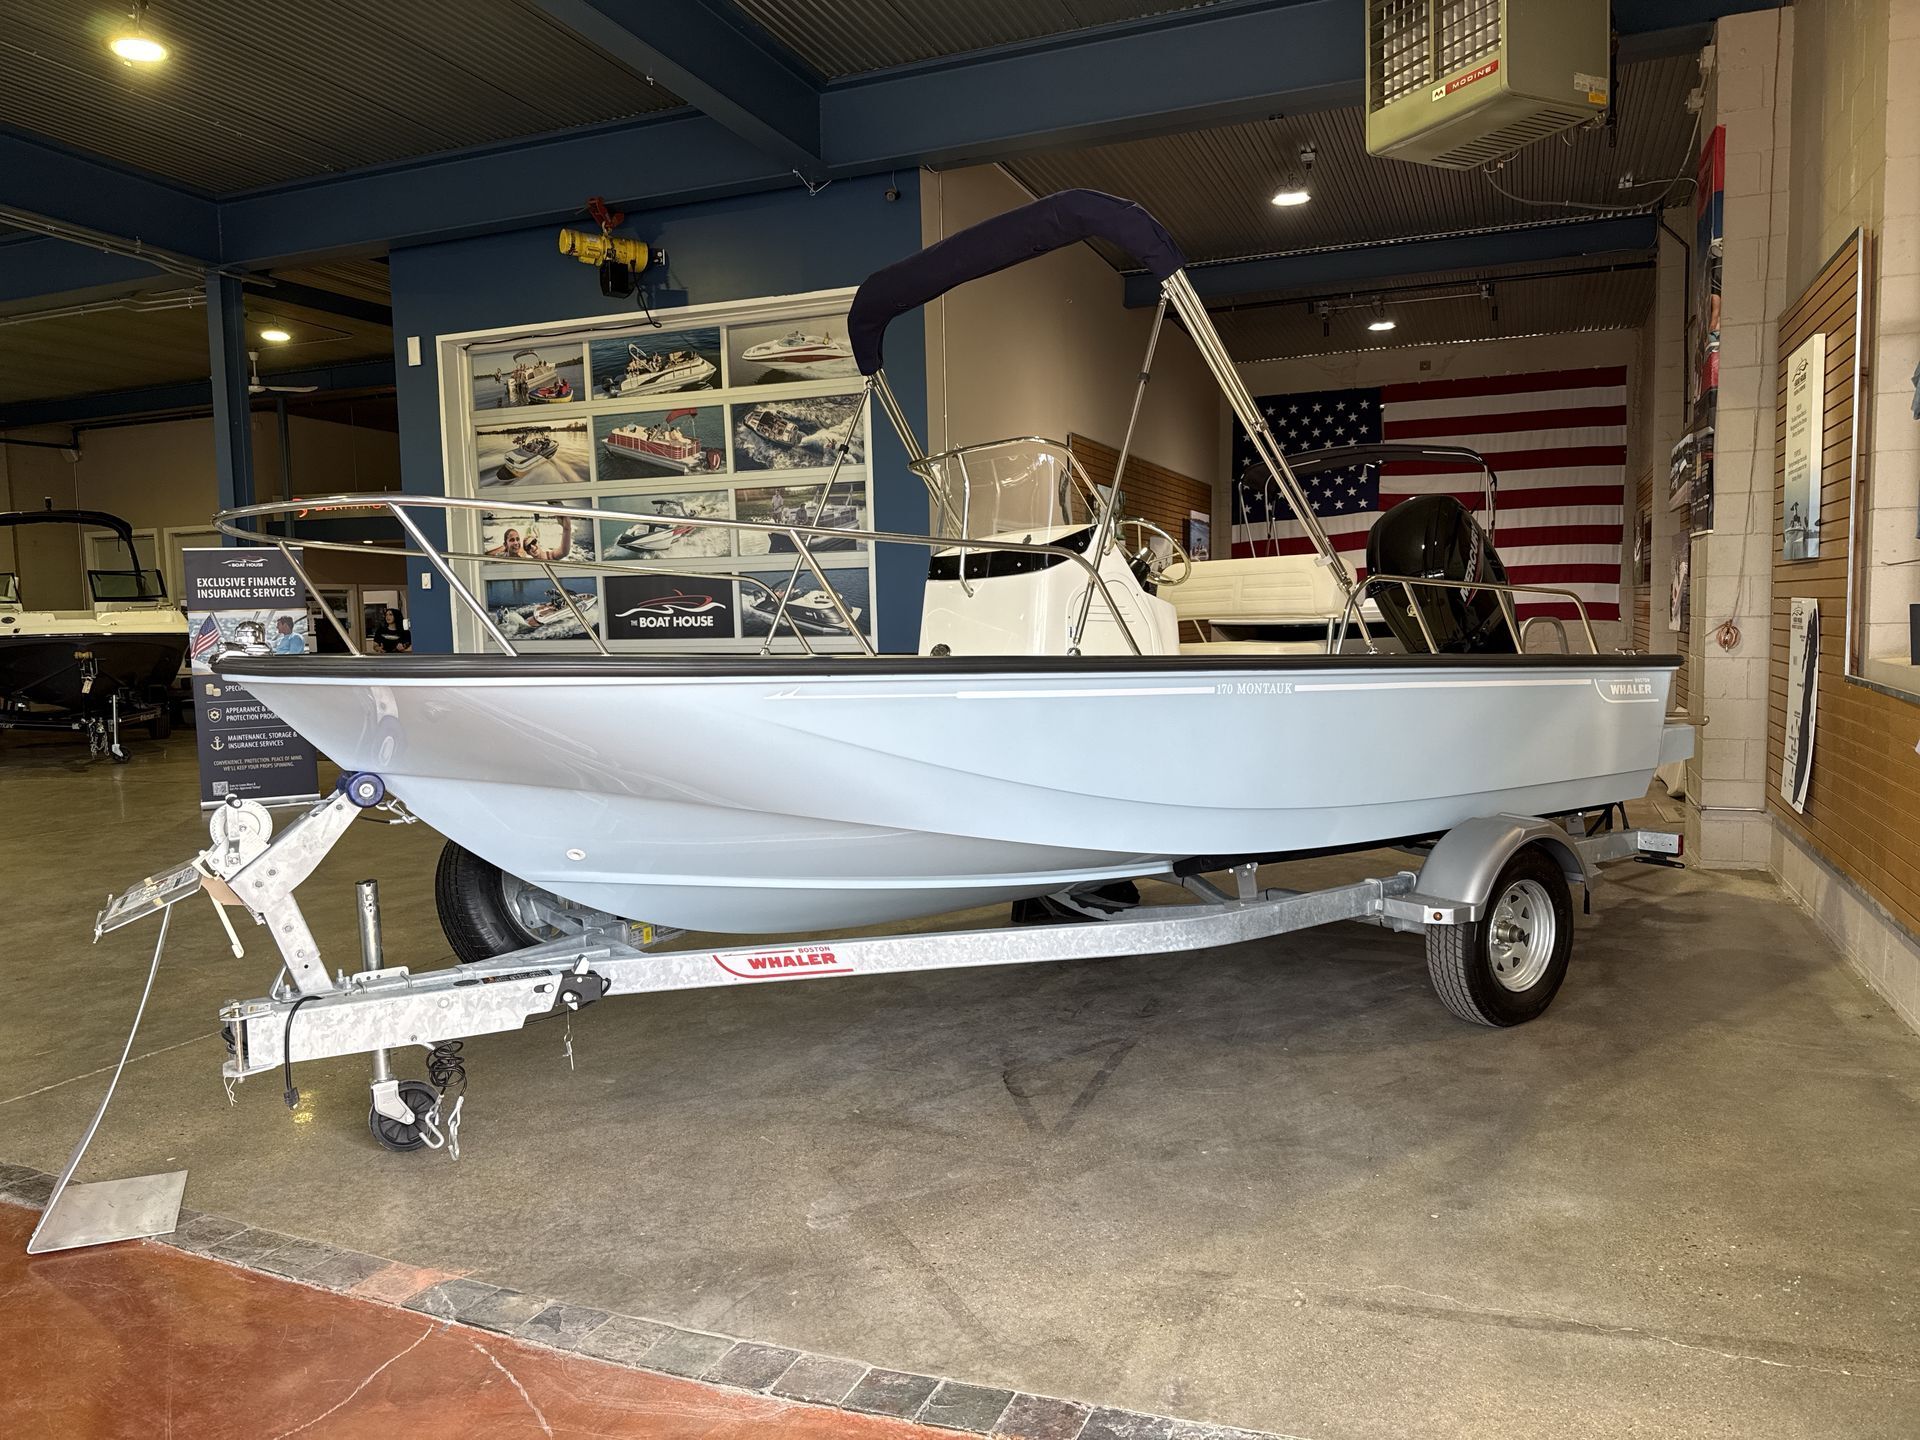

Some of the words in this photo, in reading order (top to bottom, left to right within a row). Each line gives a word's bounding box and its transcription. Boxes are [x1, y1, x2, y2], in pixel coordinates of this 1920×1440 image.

[1452, 66, 1492, 90] MODINE
[196, 577, 246, 587] EXCLUSIVE
[247, 576, 287, 586] FINANCE
[289, 576, 296, 586] &
[197, 588, 251, 599] INSURANCE
[253, 587, 296, 598] SERVICES
[639, 617, 670, 628] BOAT
[673, 616, 714, 627] HOUSE
[1217, 683, 1233, 694] 170
[1237, 682, 1293, 694] MONTAUK
[1610, 684, 1652, 695] WHALER
[225, 706, 261, 714] APPEARANCE
[226, 714, 259, 722] PROTECTION
[227, 733, 268, 741] MAINTENANCE,
[228, 741, 259, 749] INSURANCE
[260, 740, 284, 748] SERVICES
[747, 953, 838, 970] WHALER
